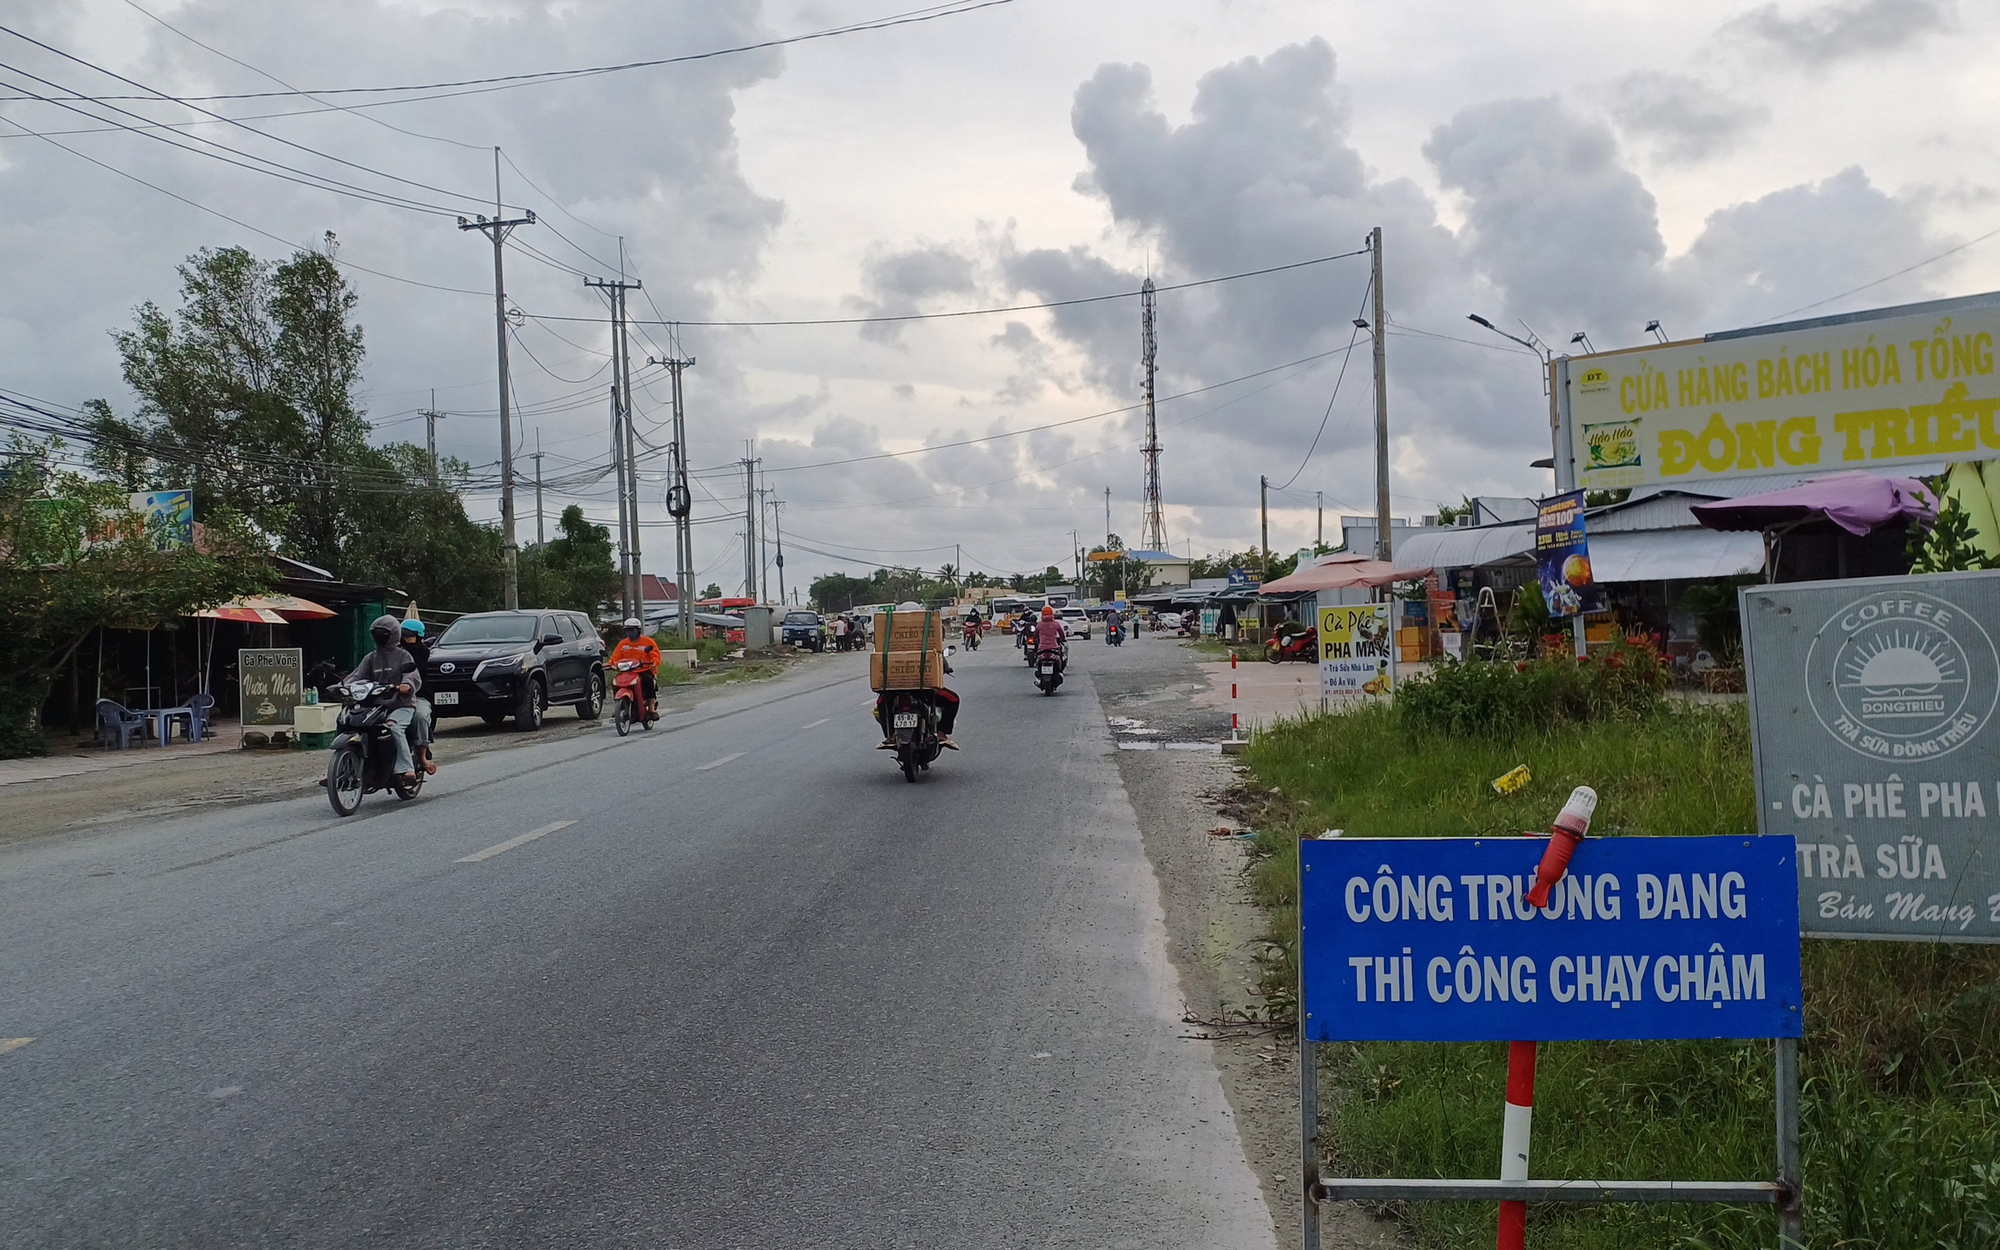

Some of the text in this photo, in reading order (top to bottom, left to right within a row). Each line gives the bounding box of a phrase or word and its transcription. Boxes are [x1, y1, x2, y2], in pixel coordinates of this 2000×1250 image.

[1619, 317, 1994, 414] CỬA HÀNG BÁCH HÓA TỔNG
[1657, 412, 1823, 477] ĐÔNG
[1323, 610, 1373, 633] Cà Phê
[1841, 600, 1953, 631] COFFEE
[1324, 642, 1352, 659] PHA
[1833, 714, 1860, 741] TRÀ
[1859, 736, 1890, 755] SỮA
[1893, 741, 1939, 757] ĐÔNG
[1791, 775, 1833, 819] CÀ
[1843, 773, 1907, 818] PHÊ
[1918, 781, 1987, 818] PHA
[1796, 834, 1947, 880] TRÀ SỮA
[1344, 864, 1454, 923] CÔNG
[1635, 871, 1748, 920] ĐANG
[1817, 890, 1875, 919] Bán
[1884, 891, 1977, 931] Mang
[1426, 945, 1538, 1004] CÔNG
[1549, 955, 1650, 1009] CHẠY
[1653, 942, 1766, 1009] CHẬM
